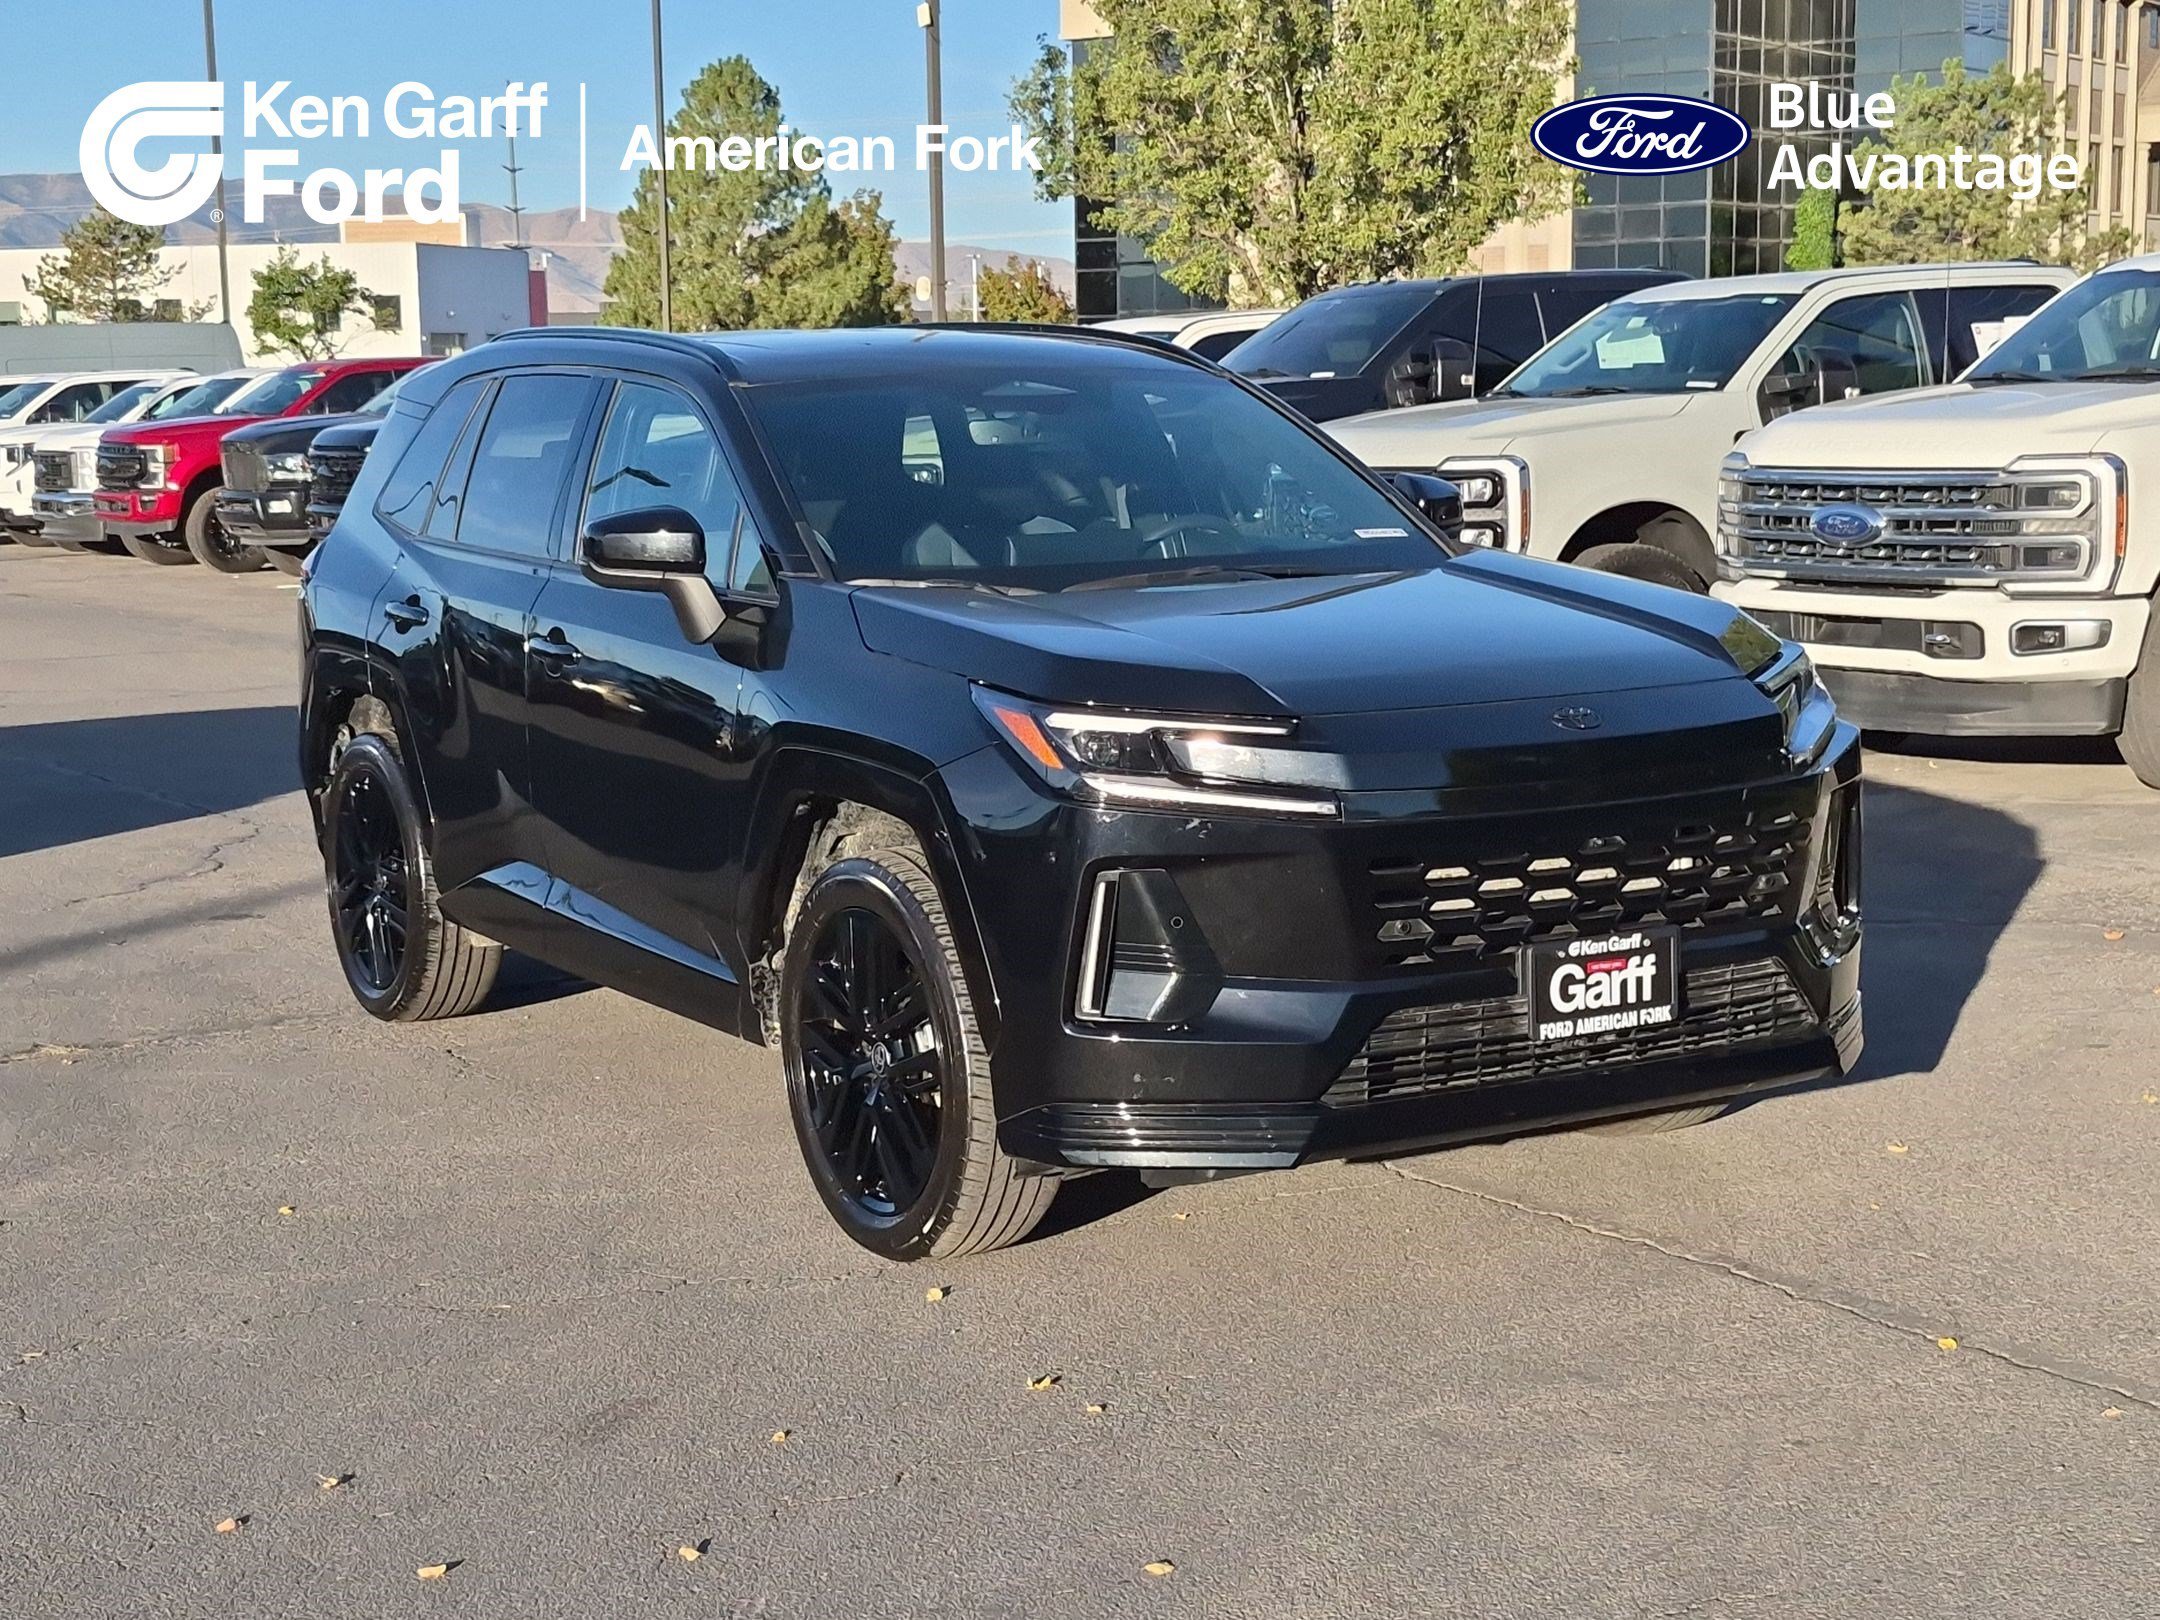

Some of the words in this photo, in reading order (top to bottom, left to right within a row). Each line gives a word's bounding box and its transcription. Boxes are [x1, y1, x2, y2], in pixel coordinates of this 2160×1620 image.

[1581, 939, 1607, 956] Ken
[1608, 933, 1642, 952] Garff
[1550, 953, 1656, 1013] Garff
[1539, 1020, 1574, 1040] FORD
[1576, 1010, 1637, 1035] AMERICAN
[1640, 1005, 1672, 1026] FORK
